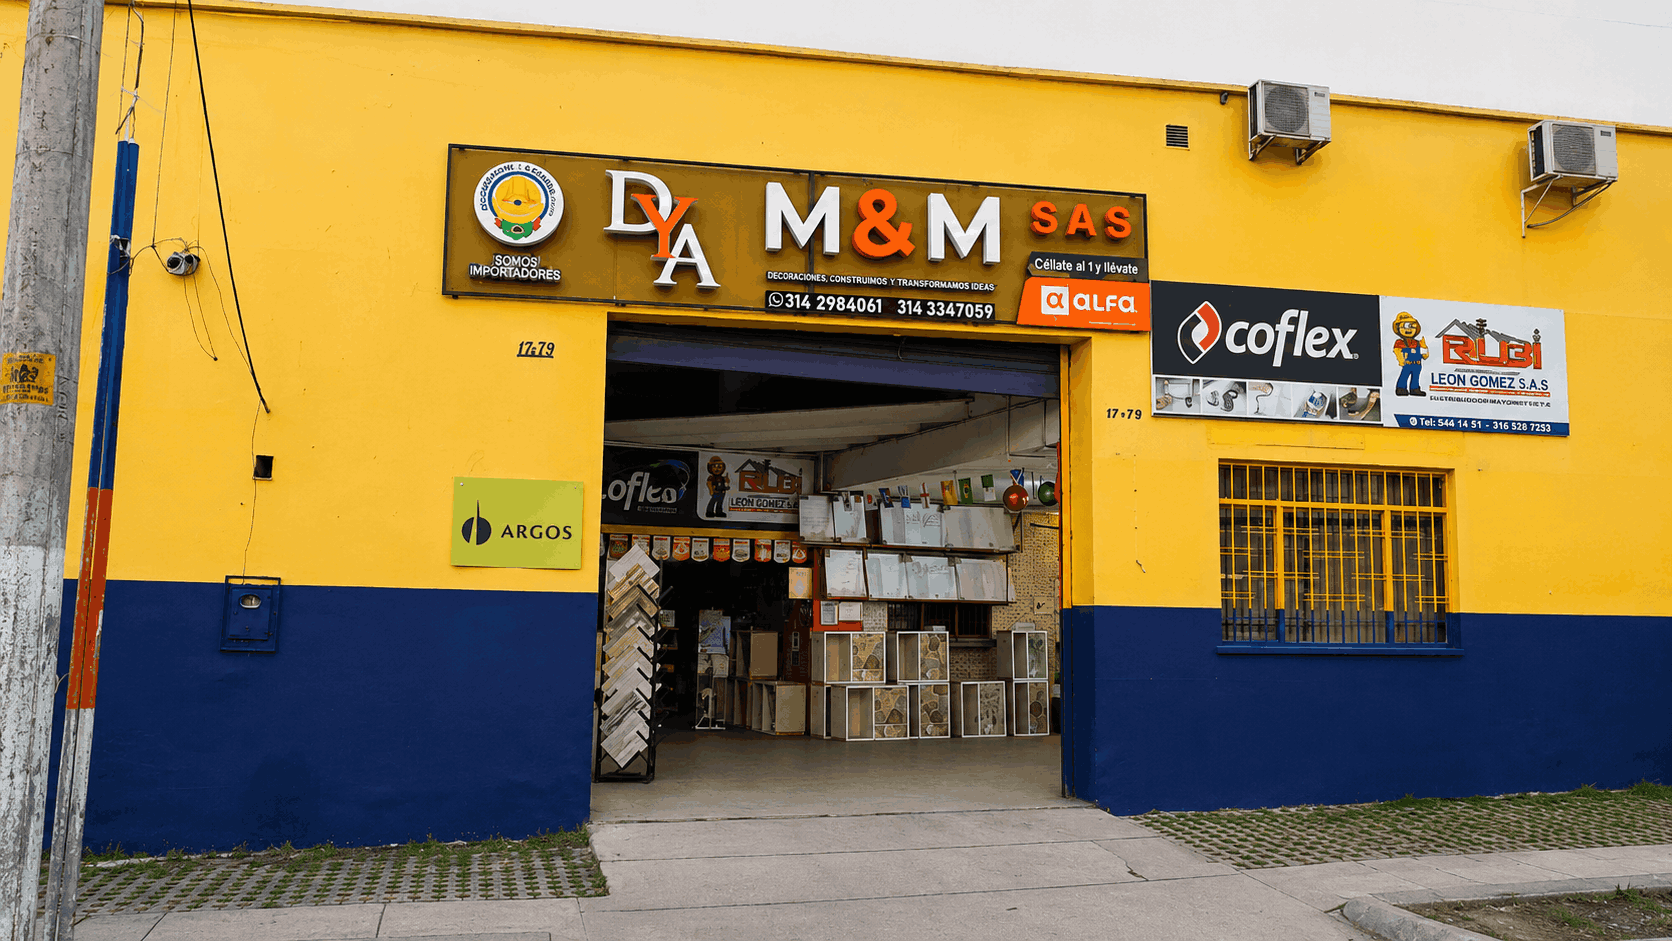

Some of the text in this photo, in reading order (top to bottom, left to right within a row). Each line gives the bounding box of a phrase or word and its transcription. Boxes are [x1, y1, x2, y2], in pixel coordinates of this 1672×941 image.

[1030, 200, 1132, 241] SAS
[495, 255, 538, 268] SOMOS
[1034, 257, 1139, 275] Céllate al 1 y llévate
[469, 265, 561, 281] IMPORTADORES
[767, 271, 995, 291] DECORACIONES, CONSTRUIMOS Y TRANSFORMAMOS IDEAS
[785, 293, 994, 319] 314 2984061 314 3347059
[1225, 309, 1359, 367] coflex
[1431, 372, 1466, 387] LEON
[1470, 375, 1516, 390] GOMEZ
[1518, 378, 1549, 391] S.A.S
[1419, 417, 1436, 428] Tel:
[1437, 419, 1455, 428] 544
[1457, 420, 1469, 429] 14
[1471, 420, 1482, 429] 51
[1492, 421, 1509, 430] 316
[1511, 422, 1528, 431] 528
[1530, 423, 1552, 433] 7253
[501, 524, 573, 541] ARGOS
